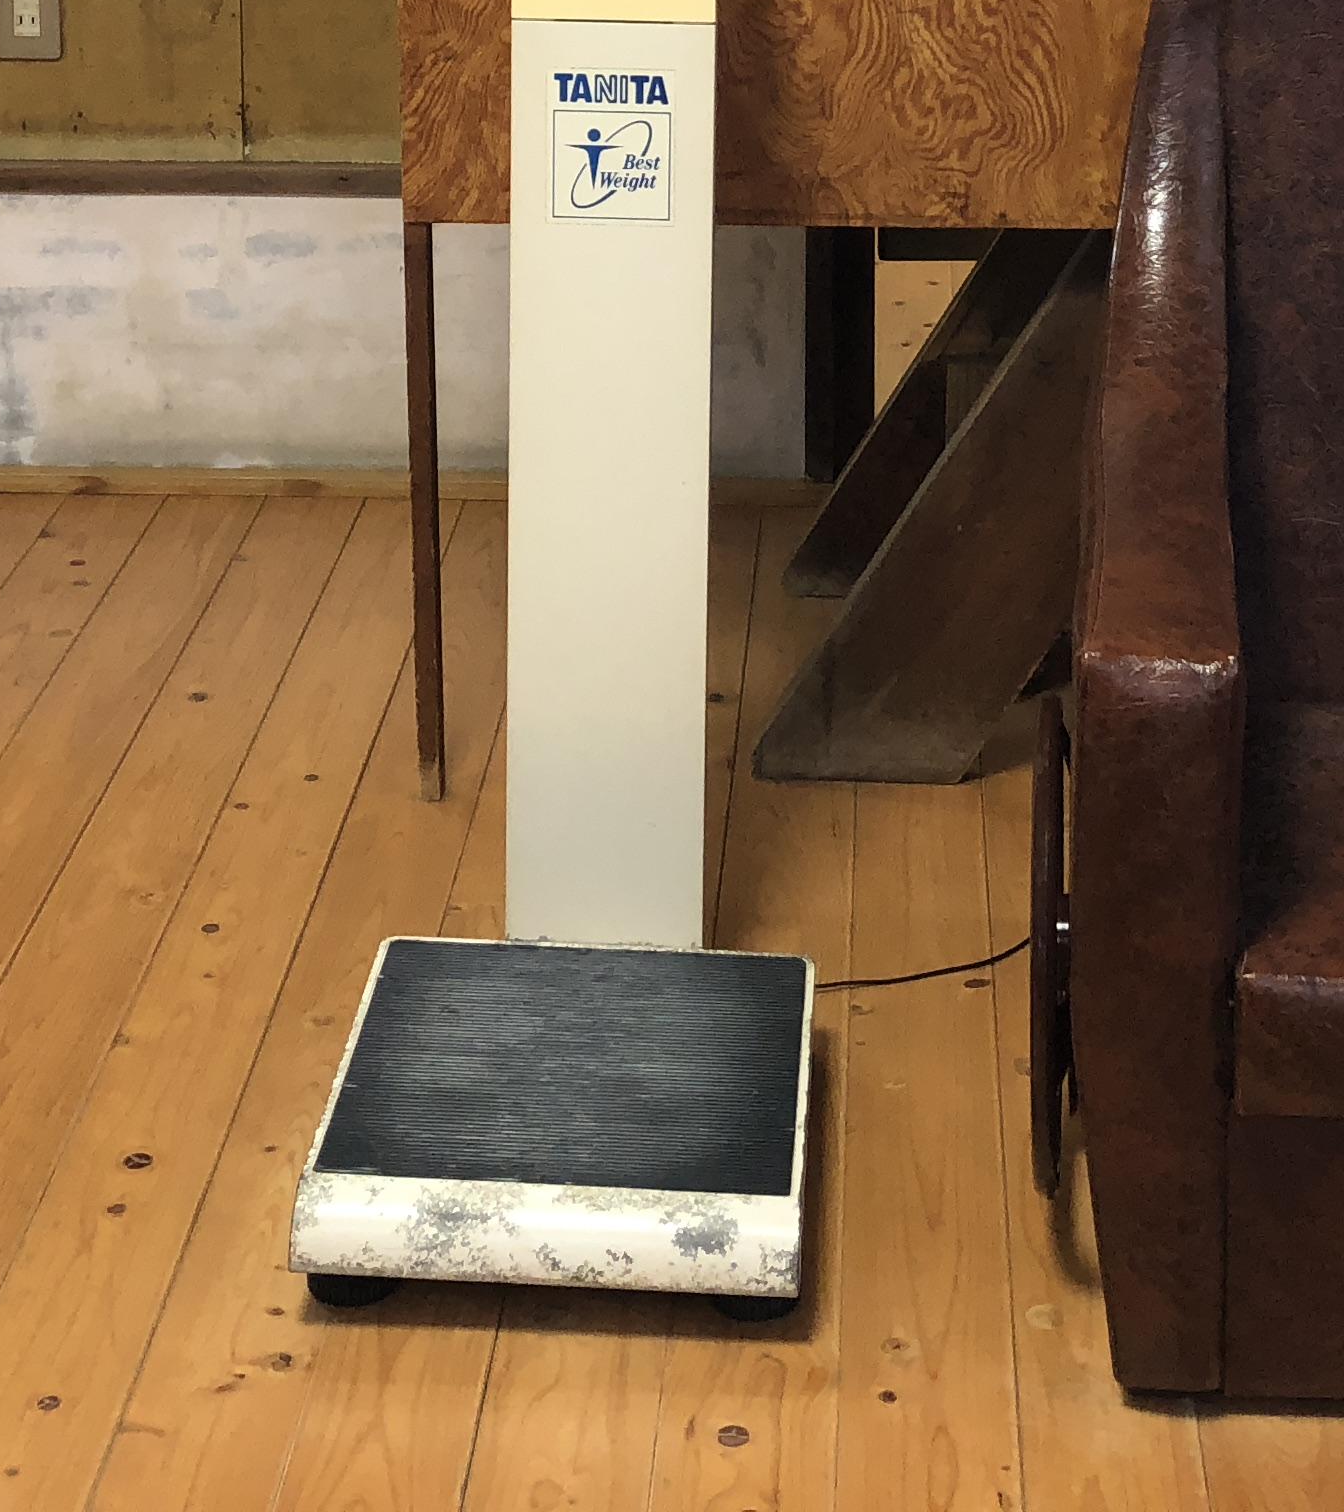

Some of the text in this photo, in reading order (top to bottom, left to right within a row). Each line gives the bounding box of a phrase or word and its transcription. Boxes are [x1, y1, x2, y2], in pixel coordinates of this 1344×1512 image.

[553, 72, 671, 106] TANITA
[622, 152, 661, 172] Best
[598, 171, 657, 193] Weight
